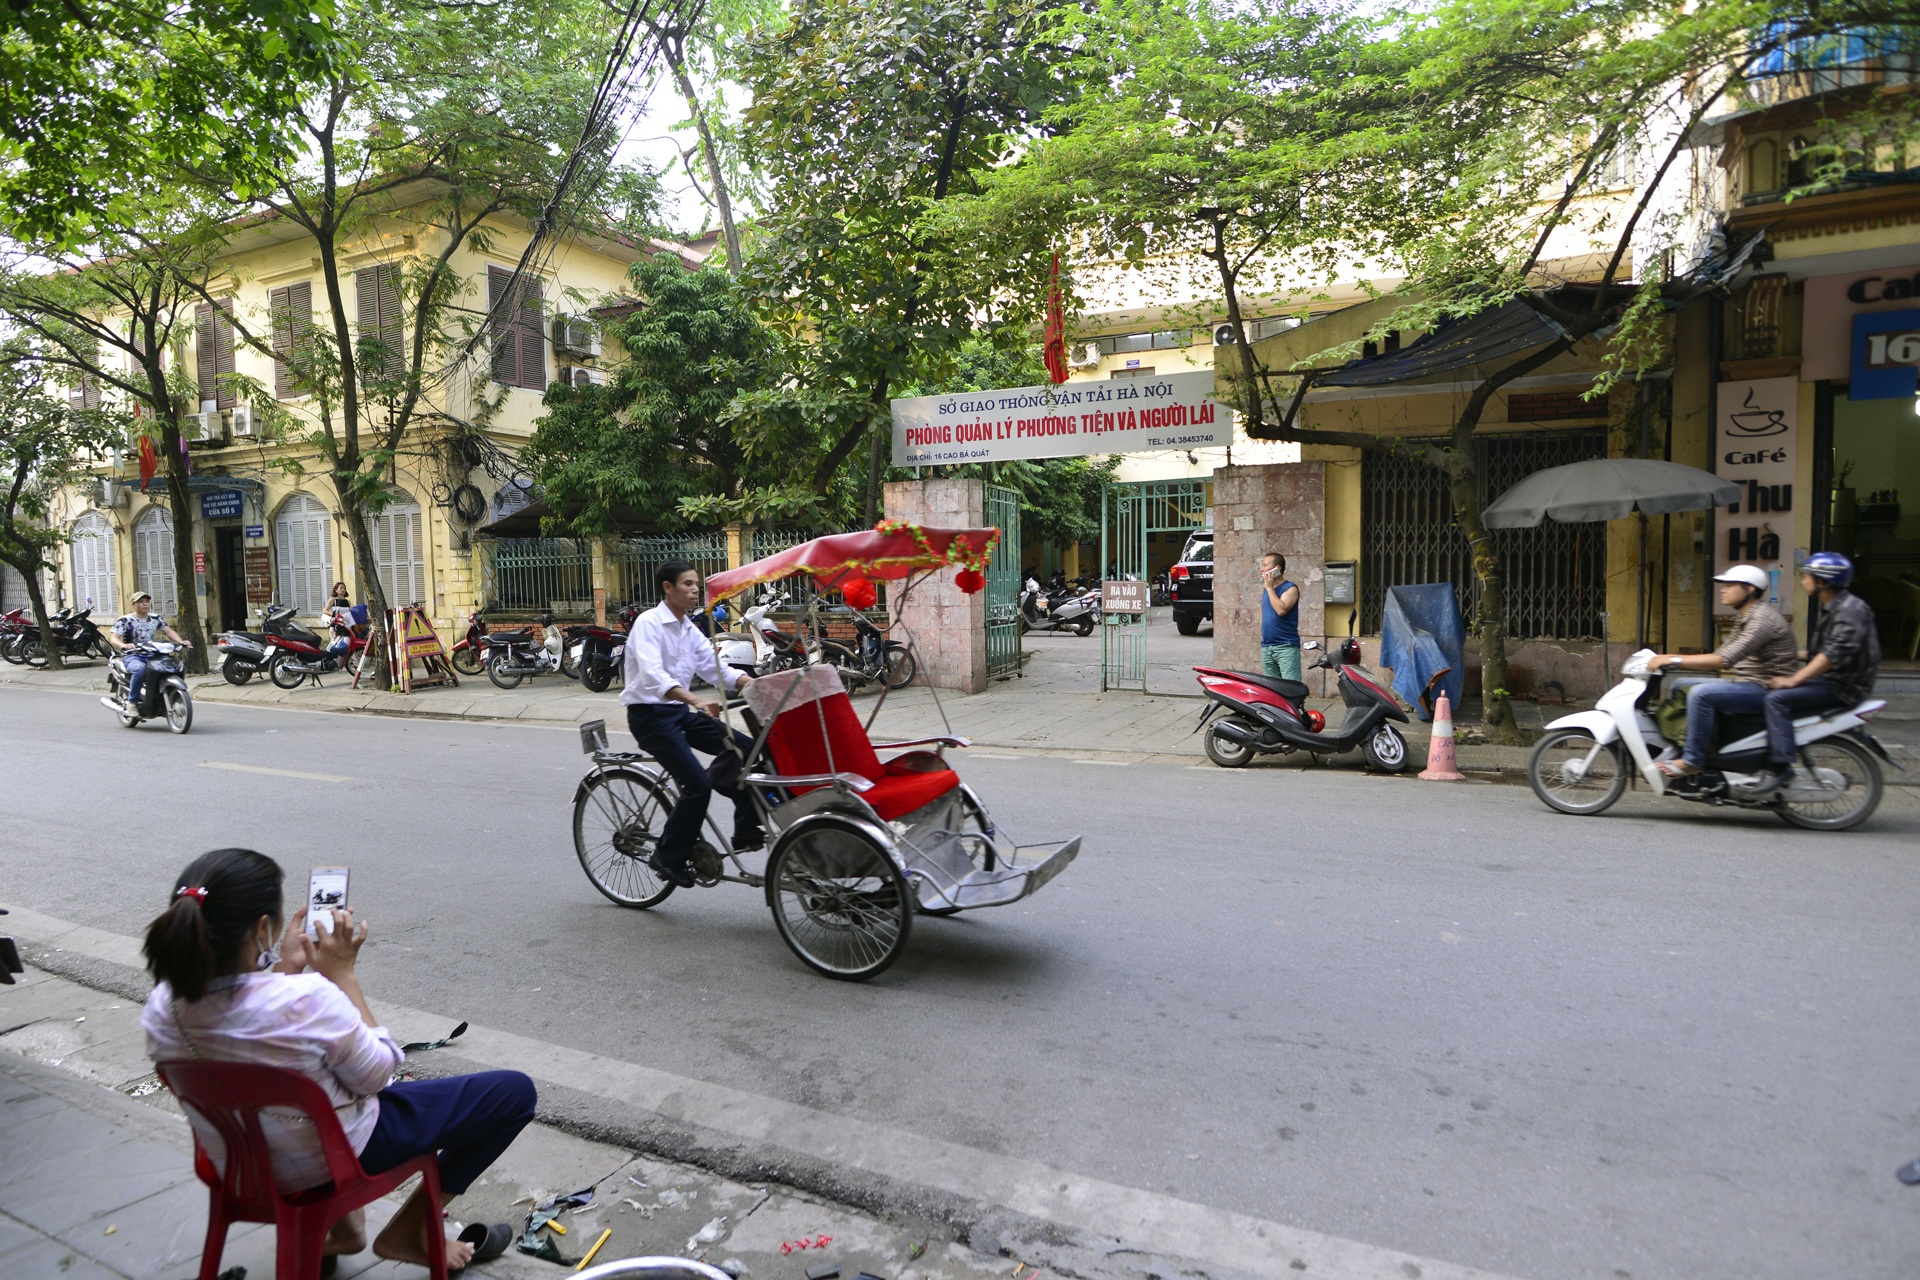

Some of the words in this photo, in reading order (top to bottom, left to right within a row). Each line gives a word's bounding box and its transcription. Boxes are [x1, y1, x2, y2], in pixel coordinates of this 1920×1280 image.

[1847, 272, 1920, 304] Ca
[1867, 333, 1920, 365] 16
[939, 398, 956, 415] SỞ
[960, 400, 995, 413] GIAO
[999, 394, 1048, 410] THÔNG
[1054, 390, 1082, 407] VẬN
[1086, 385, 1113, 403] TẢI
[1117, 384, 1139, 400] HÀ
[1144, 381, 1173, 399] NỘI
[906, 423, 951, 446] PHÒNG
[955, 416, 993, 444] QUẢN
[997, 416, 1013, 440] LÝ
[1017, 415, 1077, 439] PHƯƠNG
[1081, 409, 1115, 436] TIỆN
[1117, 407, 1137, 431] VÀ
[1140, 402, 1187, 429] NGƯỜI
[1190, 400, 1215, 425] LÁI
[906, 454, 919, 463] ĐỊA
[943, 452, 959, 460] CAO
[960, 450, 970, 458] BÁ
[971, 449, 990, 458] QUÁT
[1147, 438, 1165, 446] TEL:
[1728, 522, 1780, 561] Hà
[1105, 597, 1130, 609] XUỐNG
[1131, 600, 1142, 610] XE
[1110, 586, 1121, 596] RA
[1122, 584, 1137, 596] VÀO
